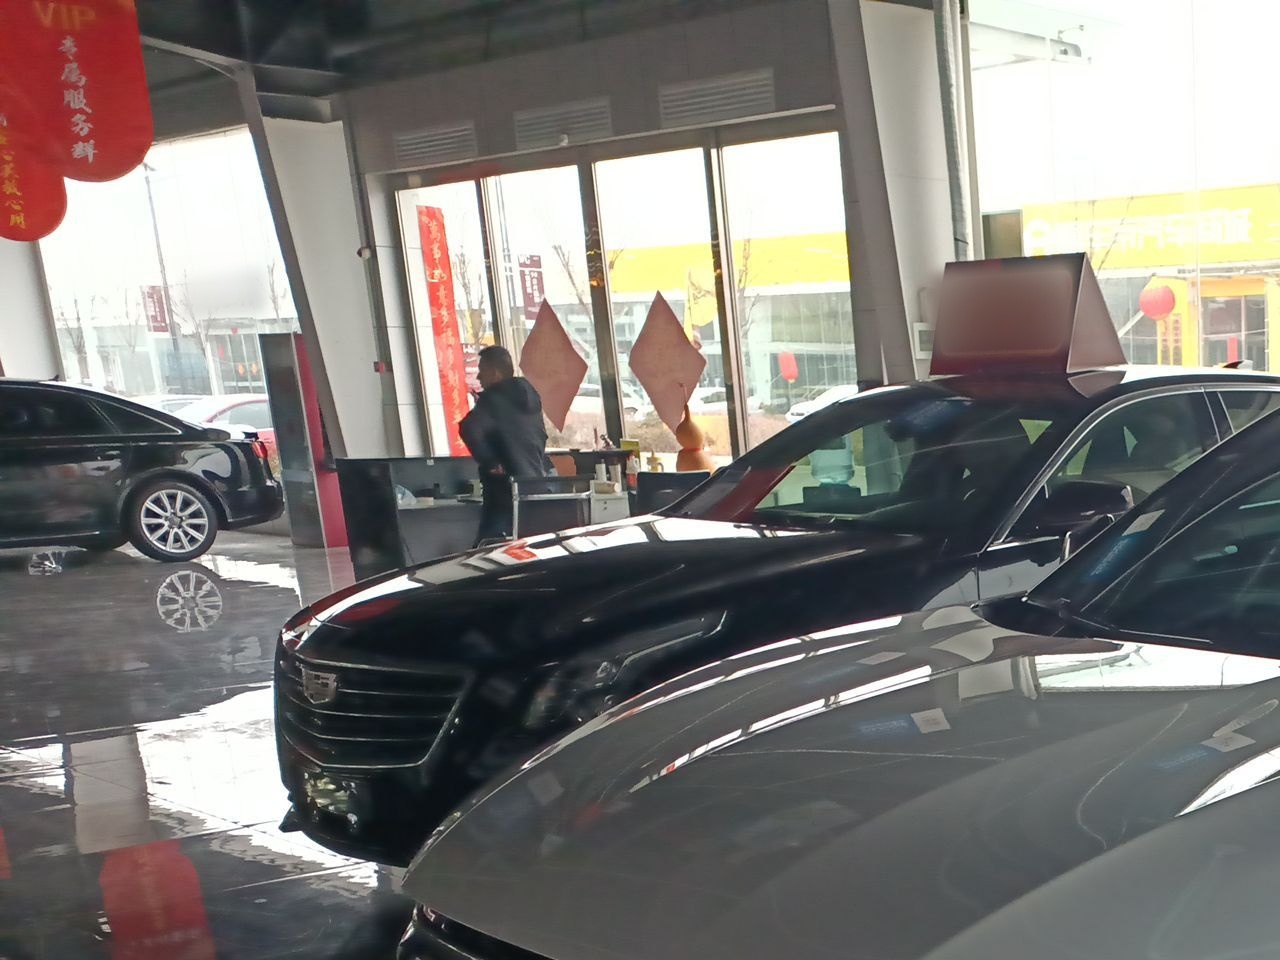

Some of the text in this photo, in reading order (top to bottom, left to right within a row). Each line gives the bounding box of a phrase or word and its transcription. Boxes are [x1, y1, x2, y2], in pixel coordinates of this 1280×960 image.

[32, 1, 97, 32] VIP
[57, 35, 100, 164] 专属服务群
